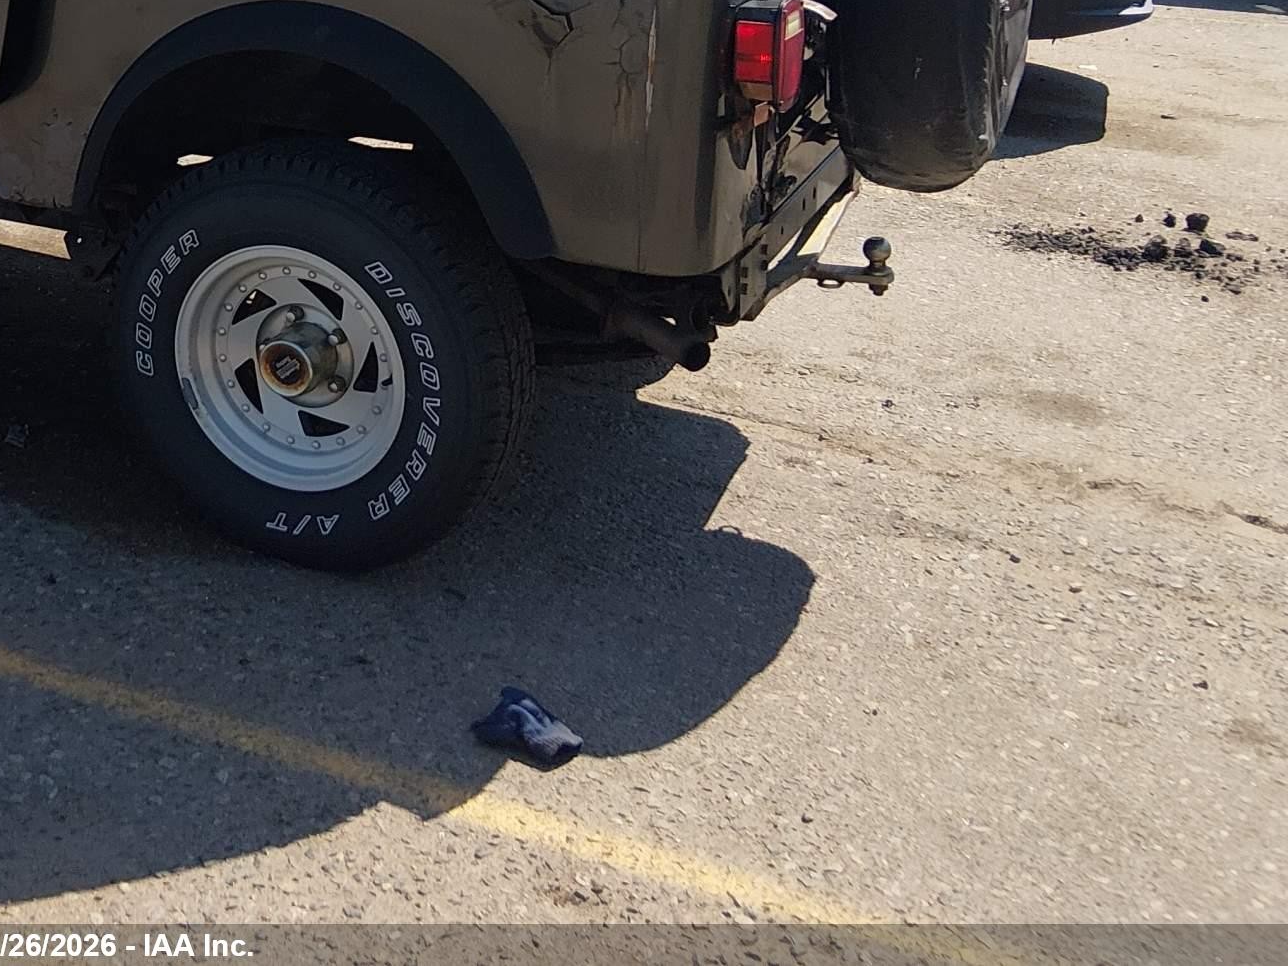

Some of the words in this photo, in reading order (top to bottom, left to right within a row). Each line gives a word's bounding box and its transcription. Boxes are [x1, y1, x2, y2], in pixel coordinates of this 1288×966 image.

[135, 229, 200, 377] COOPER
[364, 260, 441, 521] DISCOVERER
[265, 512, 340, 535] A/T
